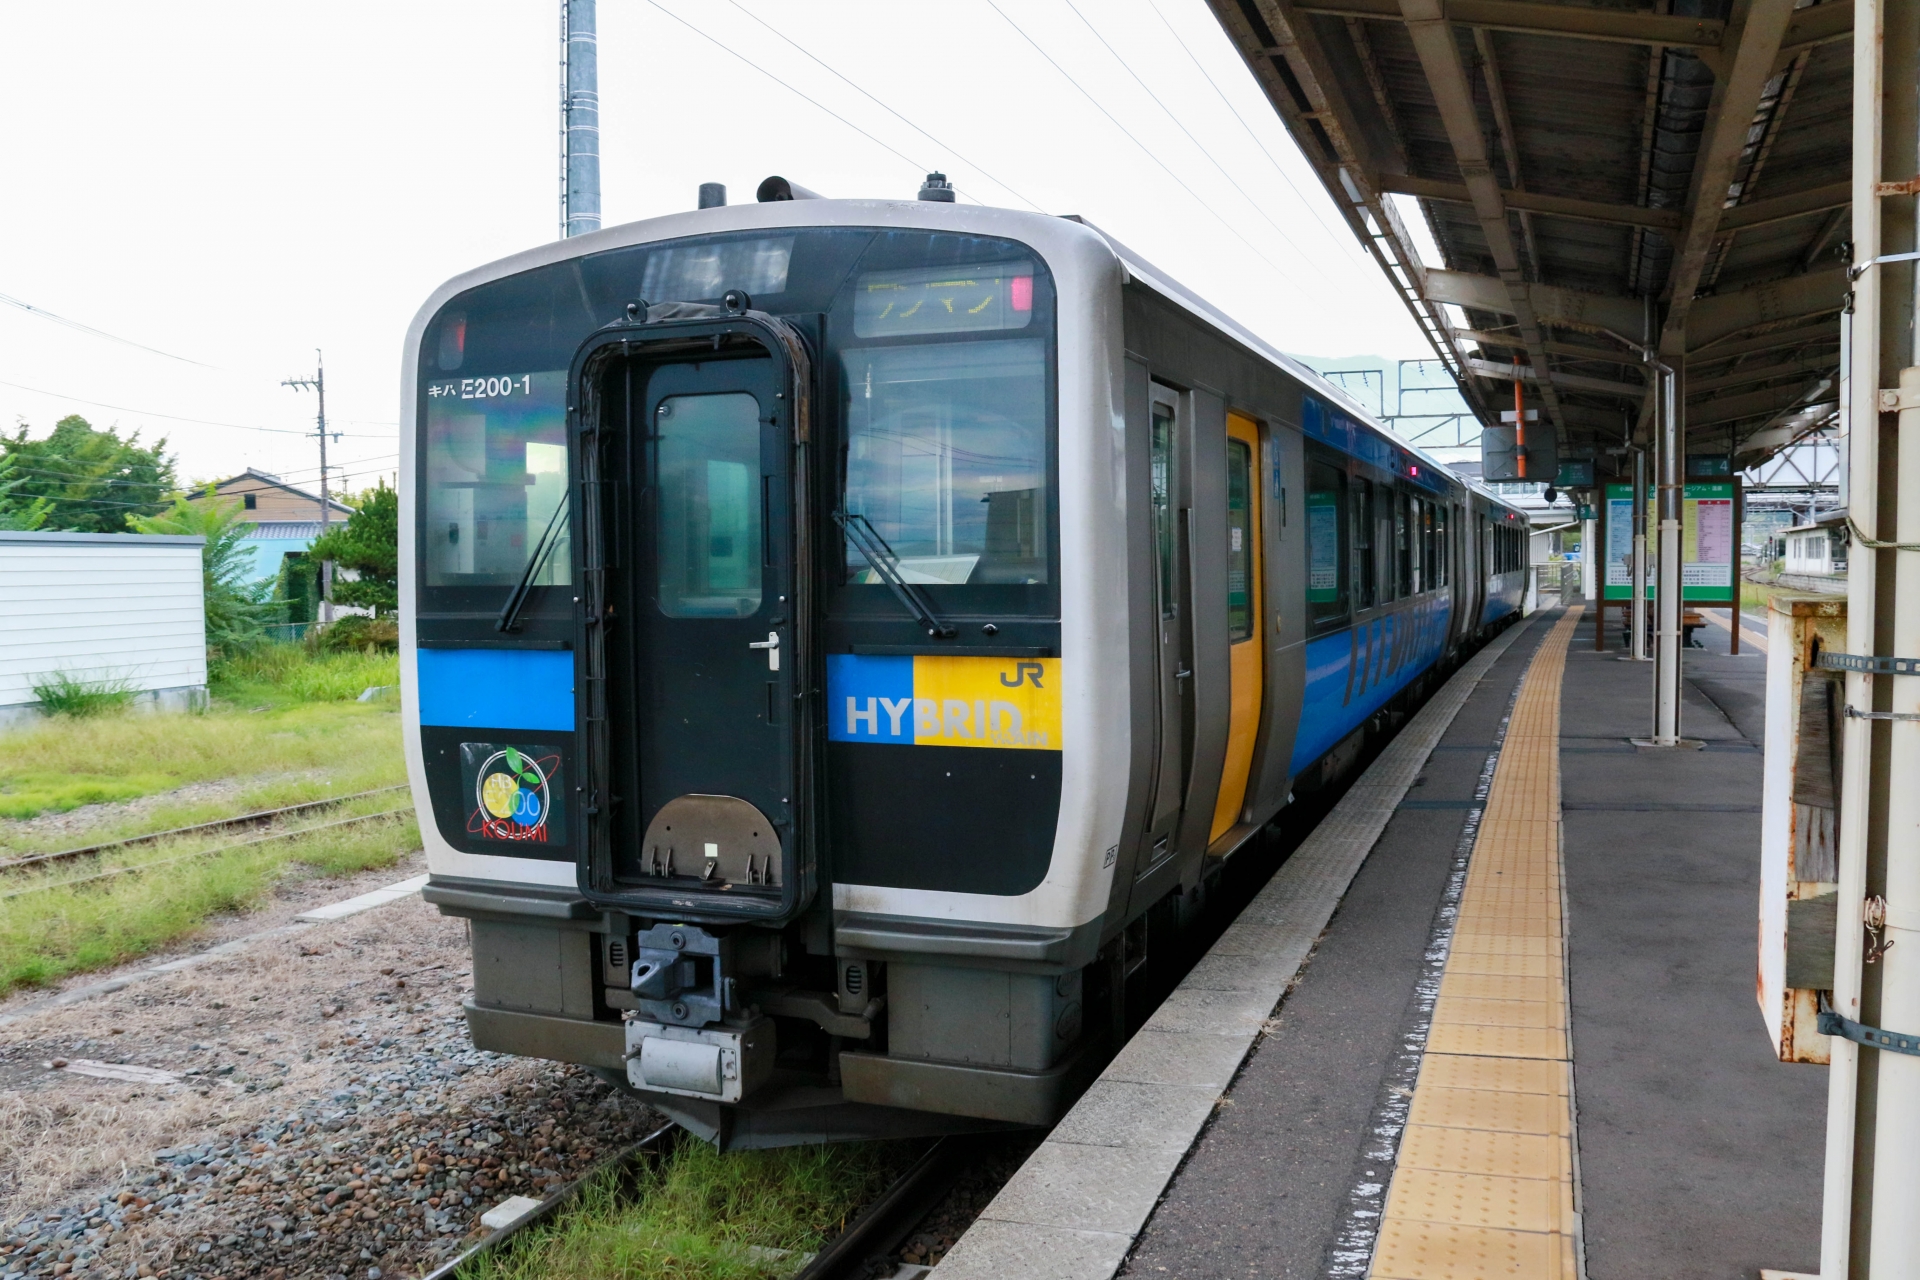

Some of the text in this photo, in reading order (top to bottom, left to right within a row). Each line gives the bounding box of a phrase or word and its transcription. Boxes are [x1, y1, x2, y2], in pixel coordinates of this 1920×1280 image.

[461, 374, 530, 399] E200-1
[1719, 460, 1729, 471] 4
[1000, 662, 1044, 688] JR
[846, 696, 1023, 739] HYBRID
[490, 774, 512, 789] HB
[481, 819, 547, 842] KOUMI
